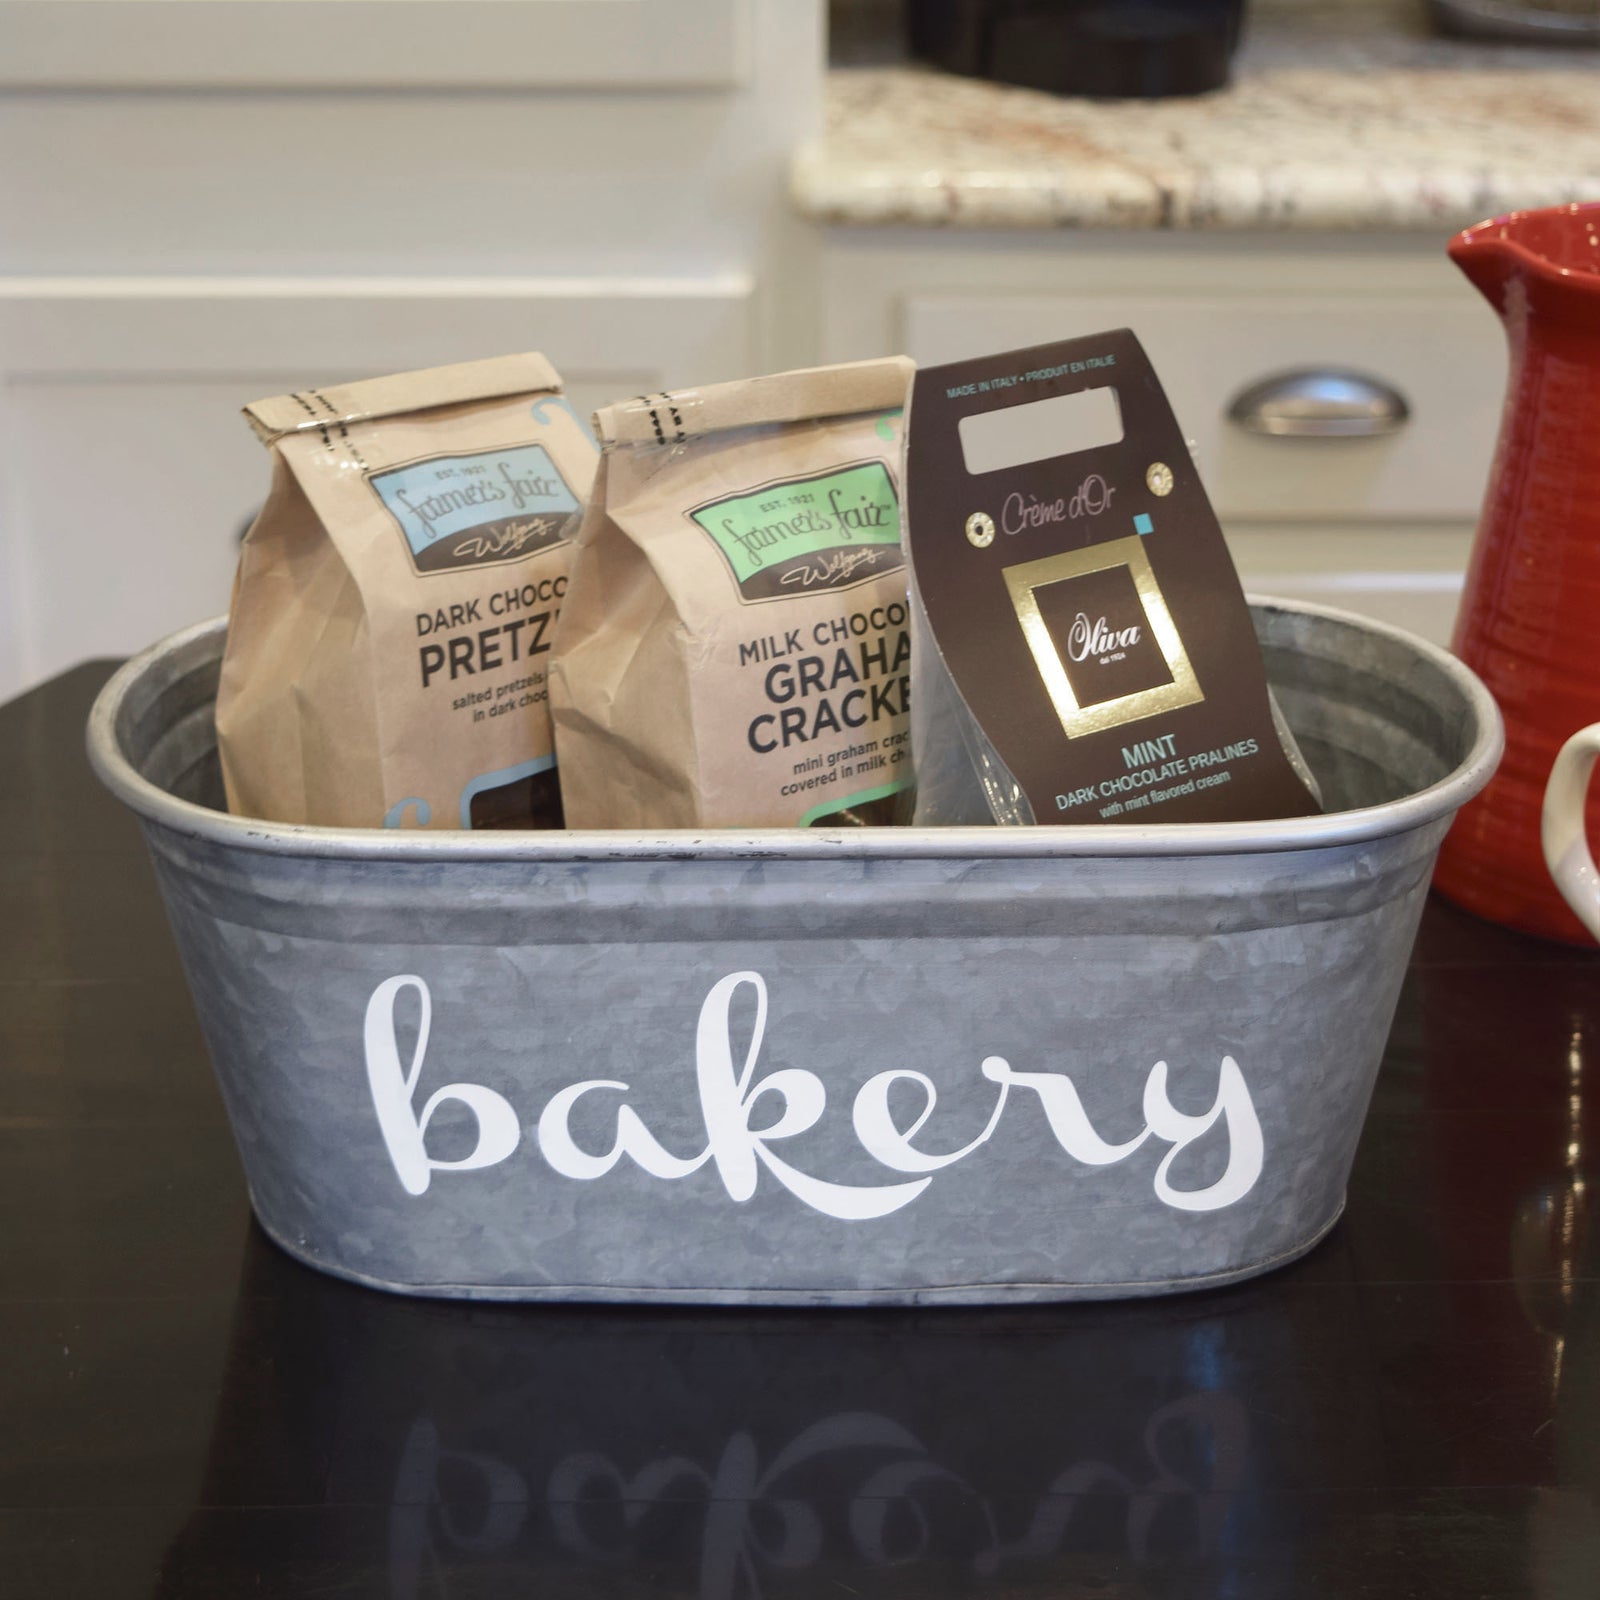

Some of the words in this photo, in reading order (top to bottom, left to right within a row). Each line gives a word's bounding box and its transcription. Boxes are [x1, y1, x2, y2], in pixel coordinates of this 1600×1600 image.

[946, 383, 977, 399] MADE
[977, 380, 991, 393] IN
[991, 375, 1018, 390] ITALY
[1025, 363, 1069, 383] PRODUIT
[1070, 361, 1086, 374] EN
[1086, 354, 1116, 370] ITALIE
[1002, 492, 1067, 535] Crème
[416, 598, 484, 637] DARK
[739, 628, 804, 667] MILK
[813, 600, 910, 646] CHOCO
[1067, 612, 1142, 662] Oliva
[419, 609, 561, 688] PRETZ
[452, 685, 493, 711] salted
[496, 671, 544, 701] pretzels
[473, 708, 486, 723] in
[488, 698, 517, 719] dark
[793, 754, 824, 776] mini
[827, 740, 878, 768] graham
[882, 729, 910, 749] crac
[1055, 785, 1099, 811] DARK
[1099, 759, 1189, 798] CHOCOLATE
[1188, 738, 1259, 771] PRALINES
[1121, 734, 1178, 769] MINT
[780, 770, 838, 797] covered
[841, 765, 854, 780] in
[856, 753, 887, 774] milk
[1099, 800, 1124, 819] with
[1124, 791, 1150, 812] mint
[1150, 779, 1196, 804] flavored
[1196, 771, 1231, 791] cream
[363, 970, 1265, 1221] bakery
